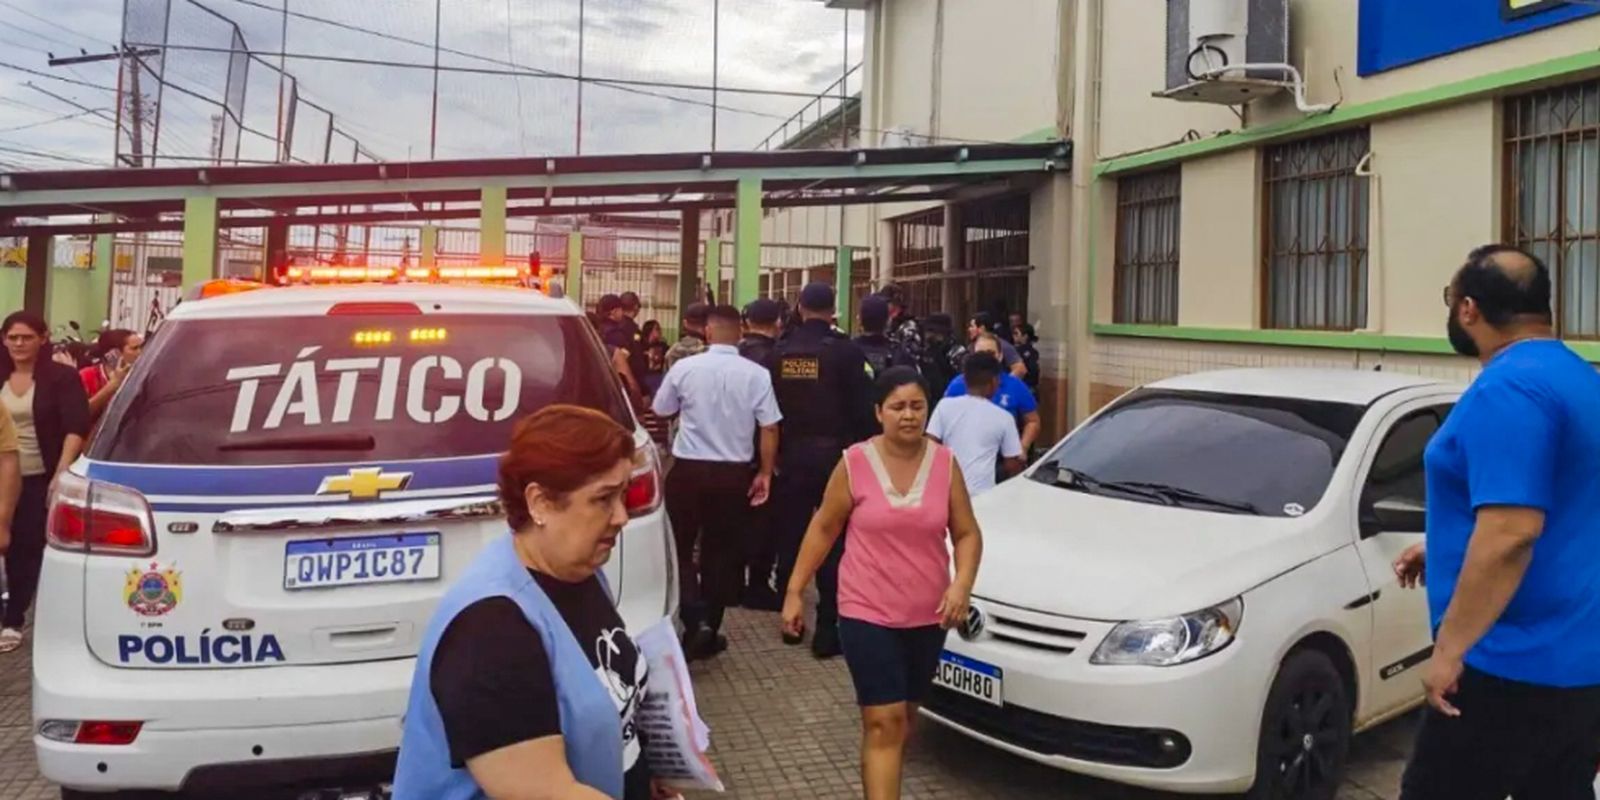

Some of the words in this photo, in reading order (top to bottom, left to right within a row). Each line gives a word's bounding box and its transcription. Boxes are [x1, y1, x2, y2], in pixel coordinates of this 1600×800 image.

[225, 345, 522, 433] TÁTICO
[298, 549, 425, 583] QWP1C87
[118, 628, 286, 664] POLÍCIA
